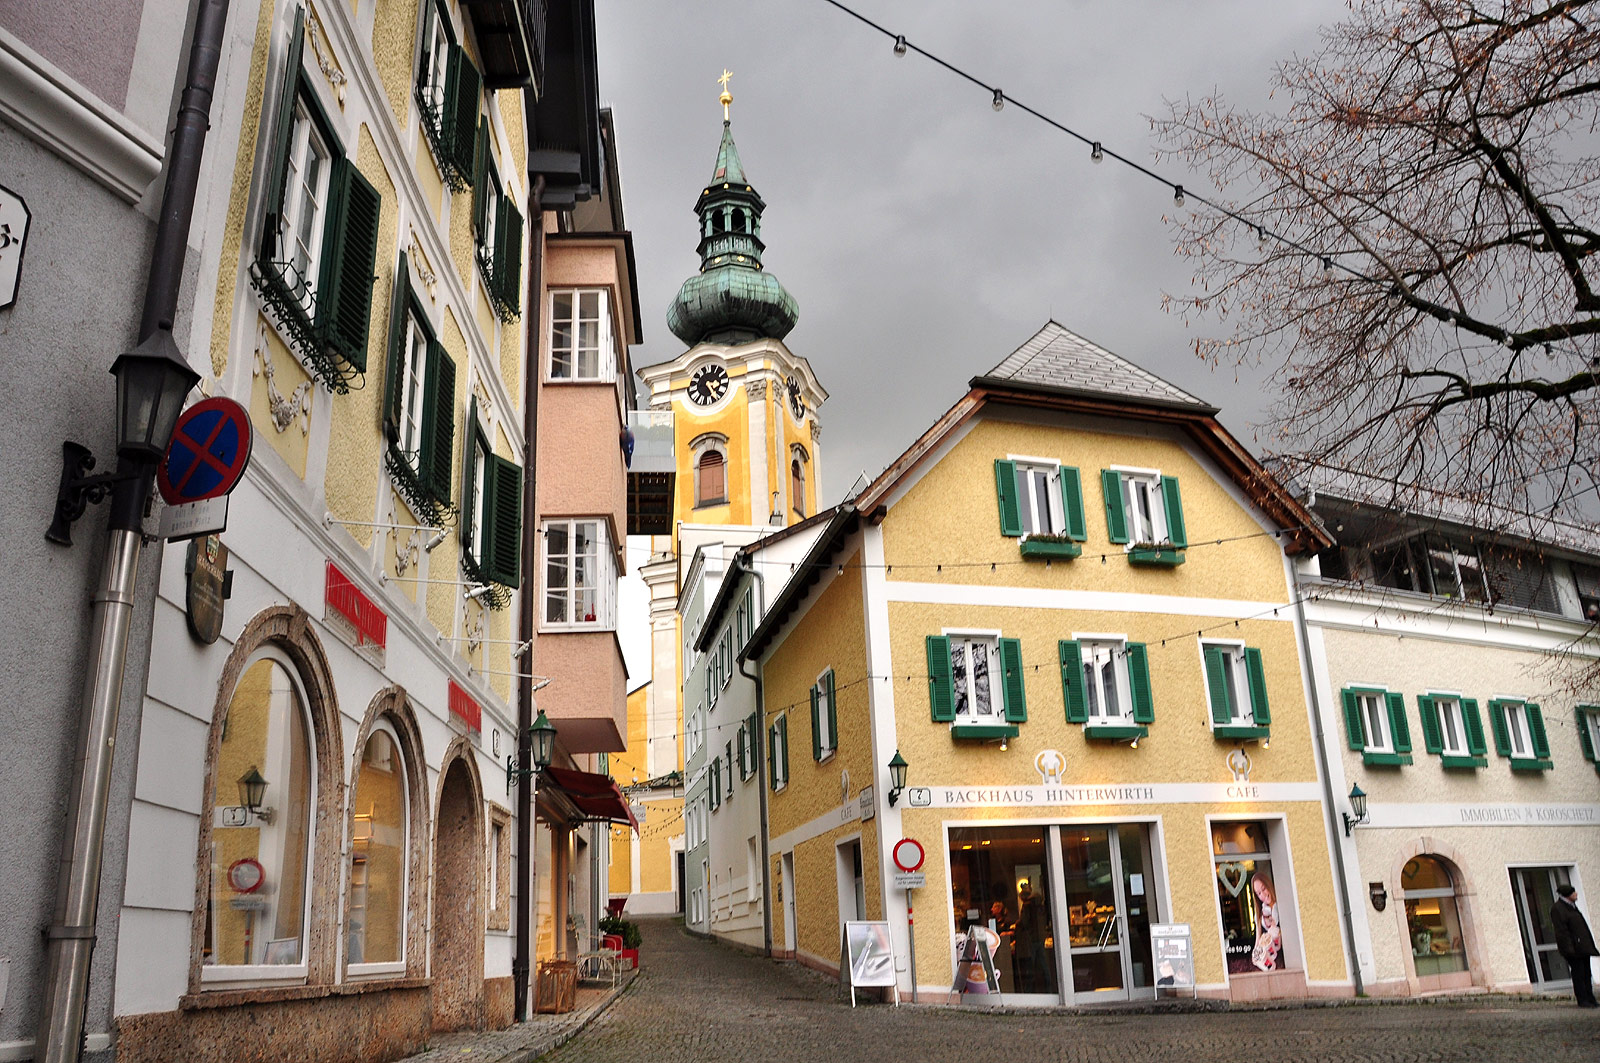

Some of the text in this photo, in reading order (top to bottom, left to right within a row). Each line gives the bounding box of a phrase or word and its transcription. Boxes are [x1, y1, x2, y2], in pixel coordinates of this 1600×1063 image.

[916, 789, 923, 800] 7
[945, 787, 1154, 803] BACKHAUS HINTERWIRTH
[1226, 786, 1260, 798] CAFE
[1460, 807, 1594, 822] IMMOBILIEN KOROSCHETZ
[1243, 944, 1252, 954] go
